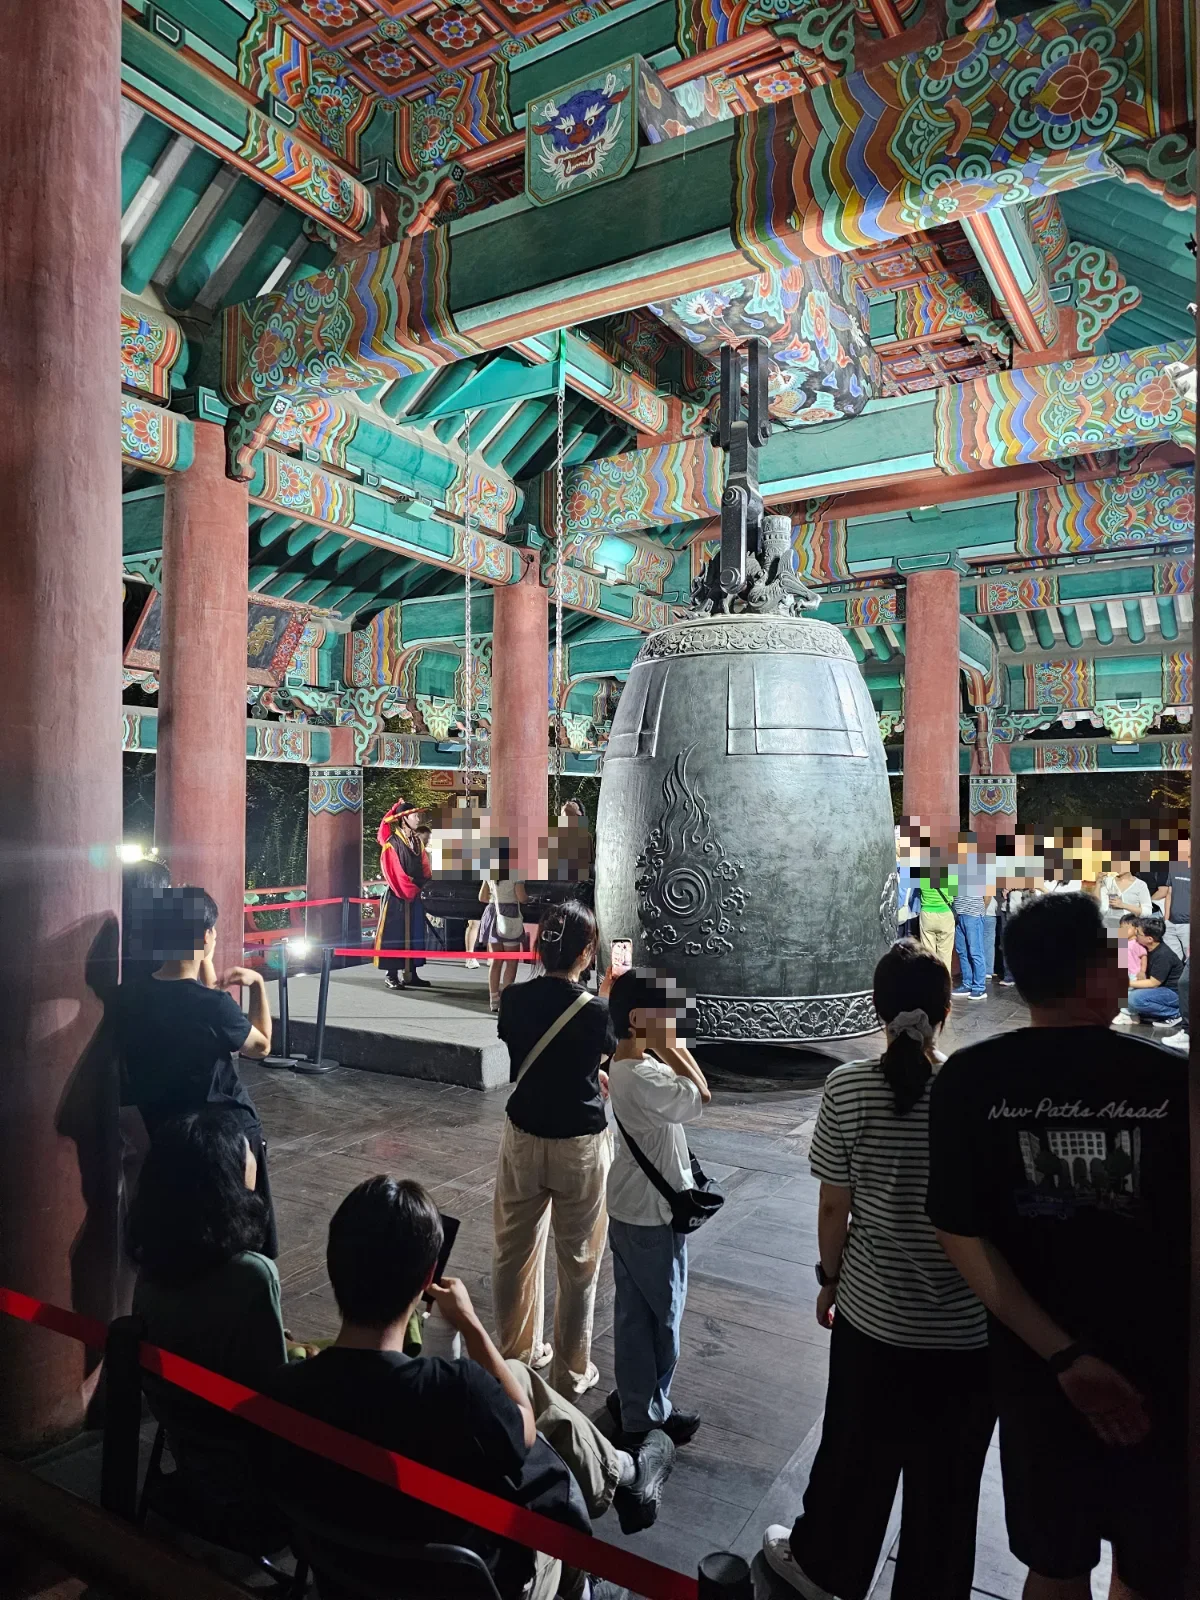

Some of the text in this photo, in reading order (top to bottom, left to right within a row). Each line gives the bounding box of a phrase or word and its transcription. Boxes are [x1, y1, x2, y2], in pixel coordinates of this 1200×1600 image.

[988, 1097, 1169, 1120] New Paths Ahead
